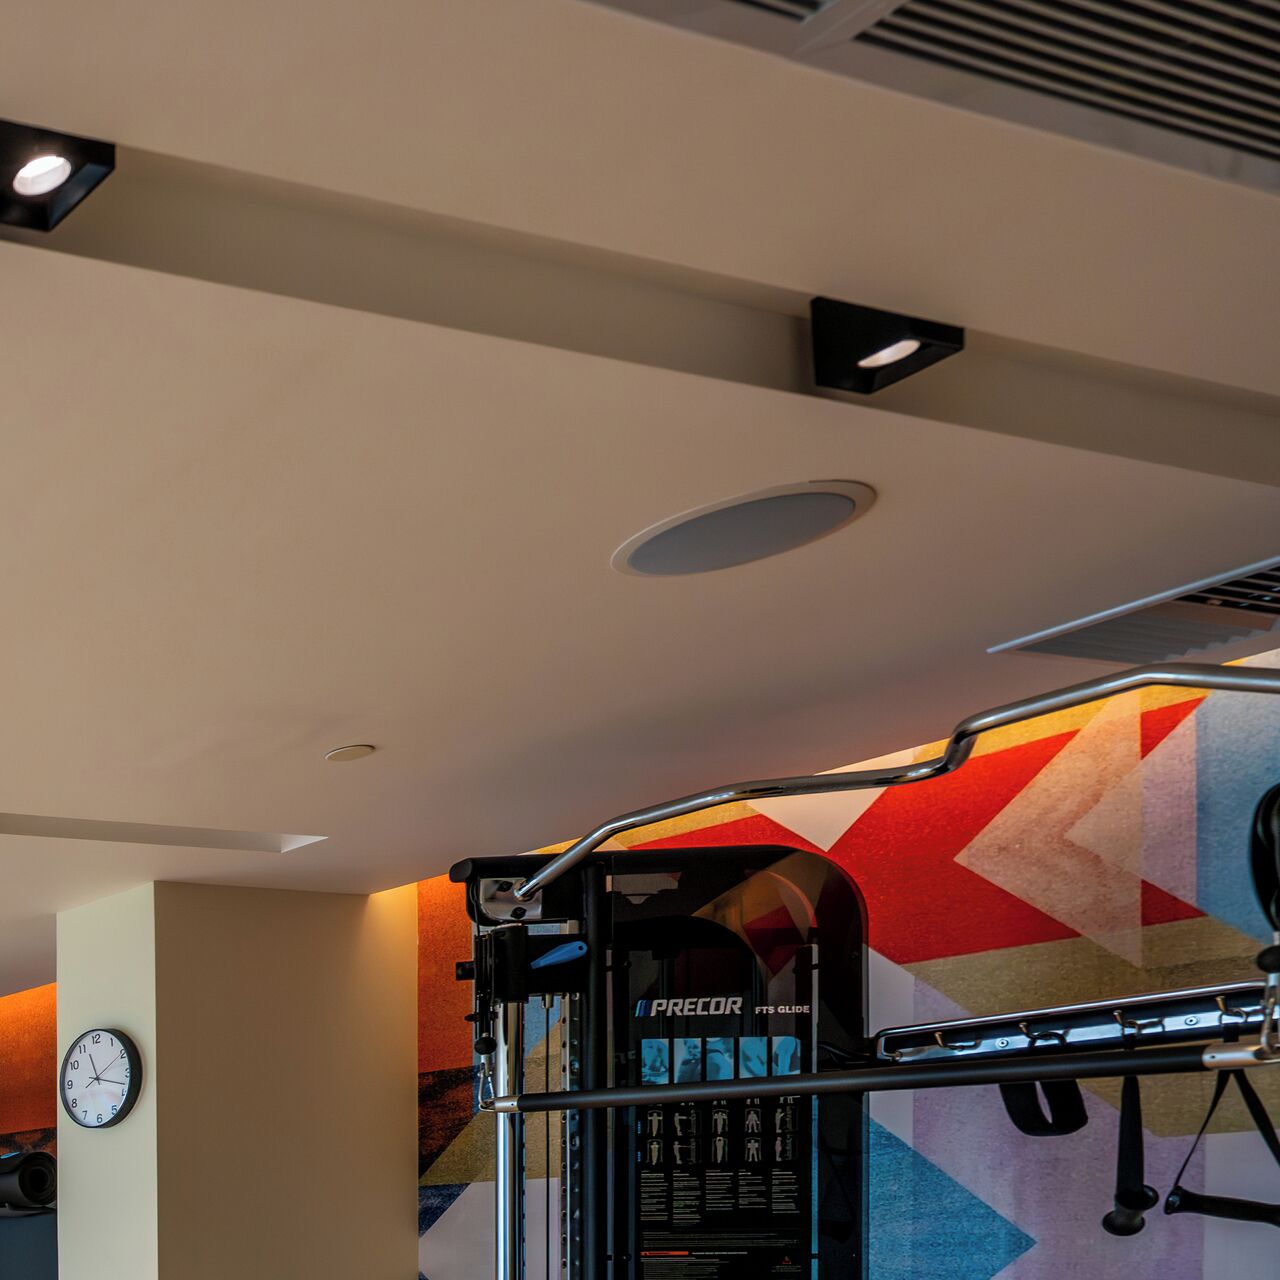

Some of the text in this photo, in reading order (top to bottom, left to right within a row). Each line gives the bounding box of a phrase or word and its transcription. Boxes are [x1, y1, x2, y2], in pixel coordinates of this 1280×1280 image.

[650, 996, 810, 1017] PRECOR FTS GLIDE
[92, 1033, 101, 1045] 12
[79, 1044, 86, 1055] 11
[120, 1049, 127, 1059] 2
[70, 1060, 79, 1071] 10
[67, 1079, 73, 1090] 9
[71, 1098, 78, 1108] 8
[82, 1110, 88, 1121] 7
[111, 1105, 118, 1116] 5
[96, 1113, 103, 1124] 6
